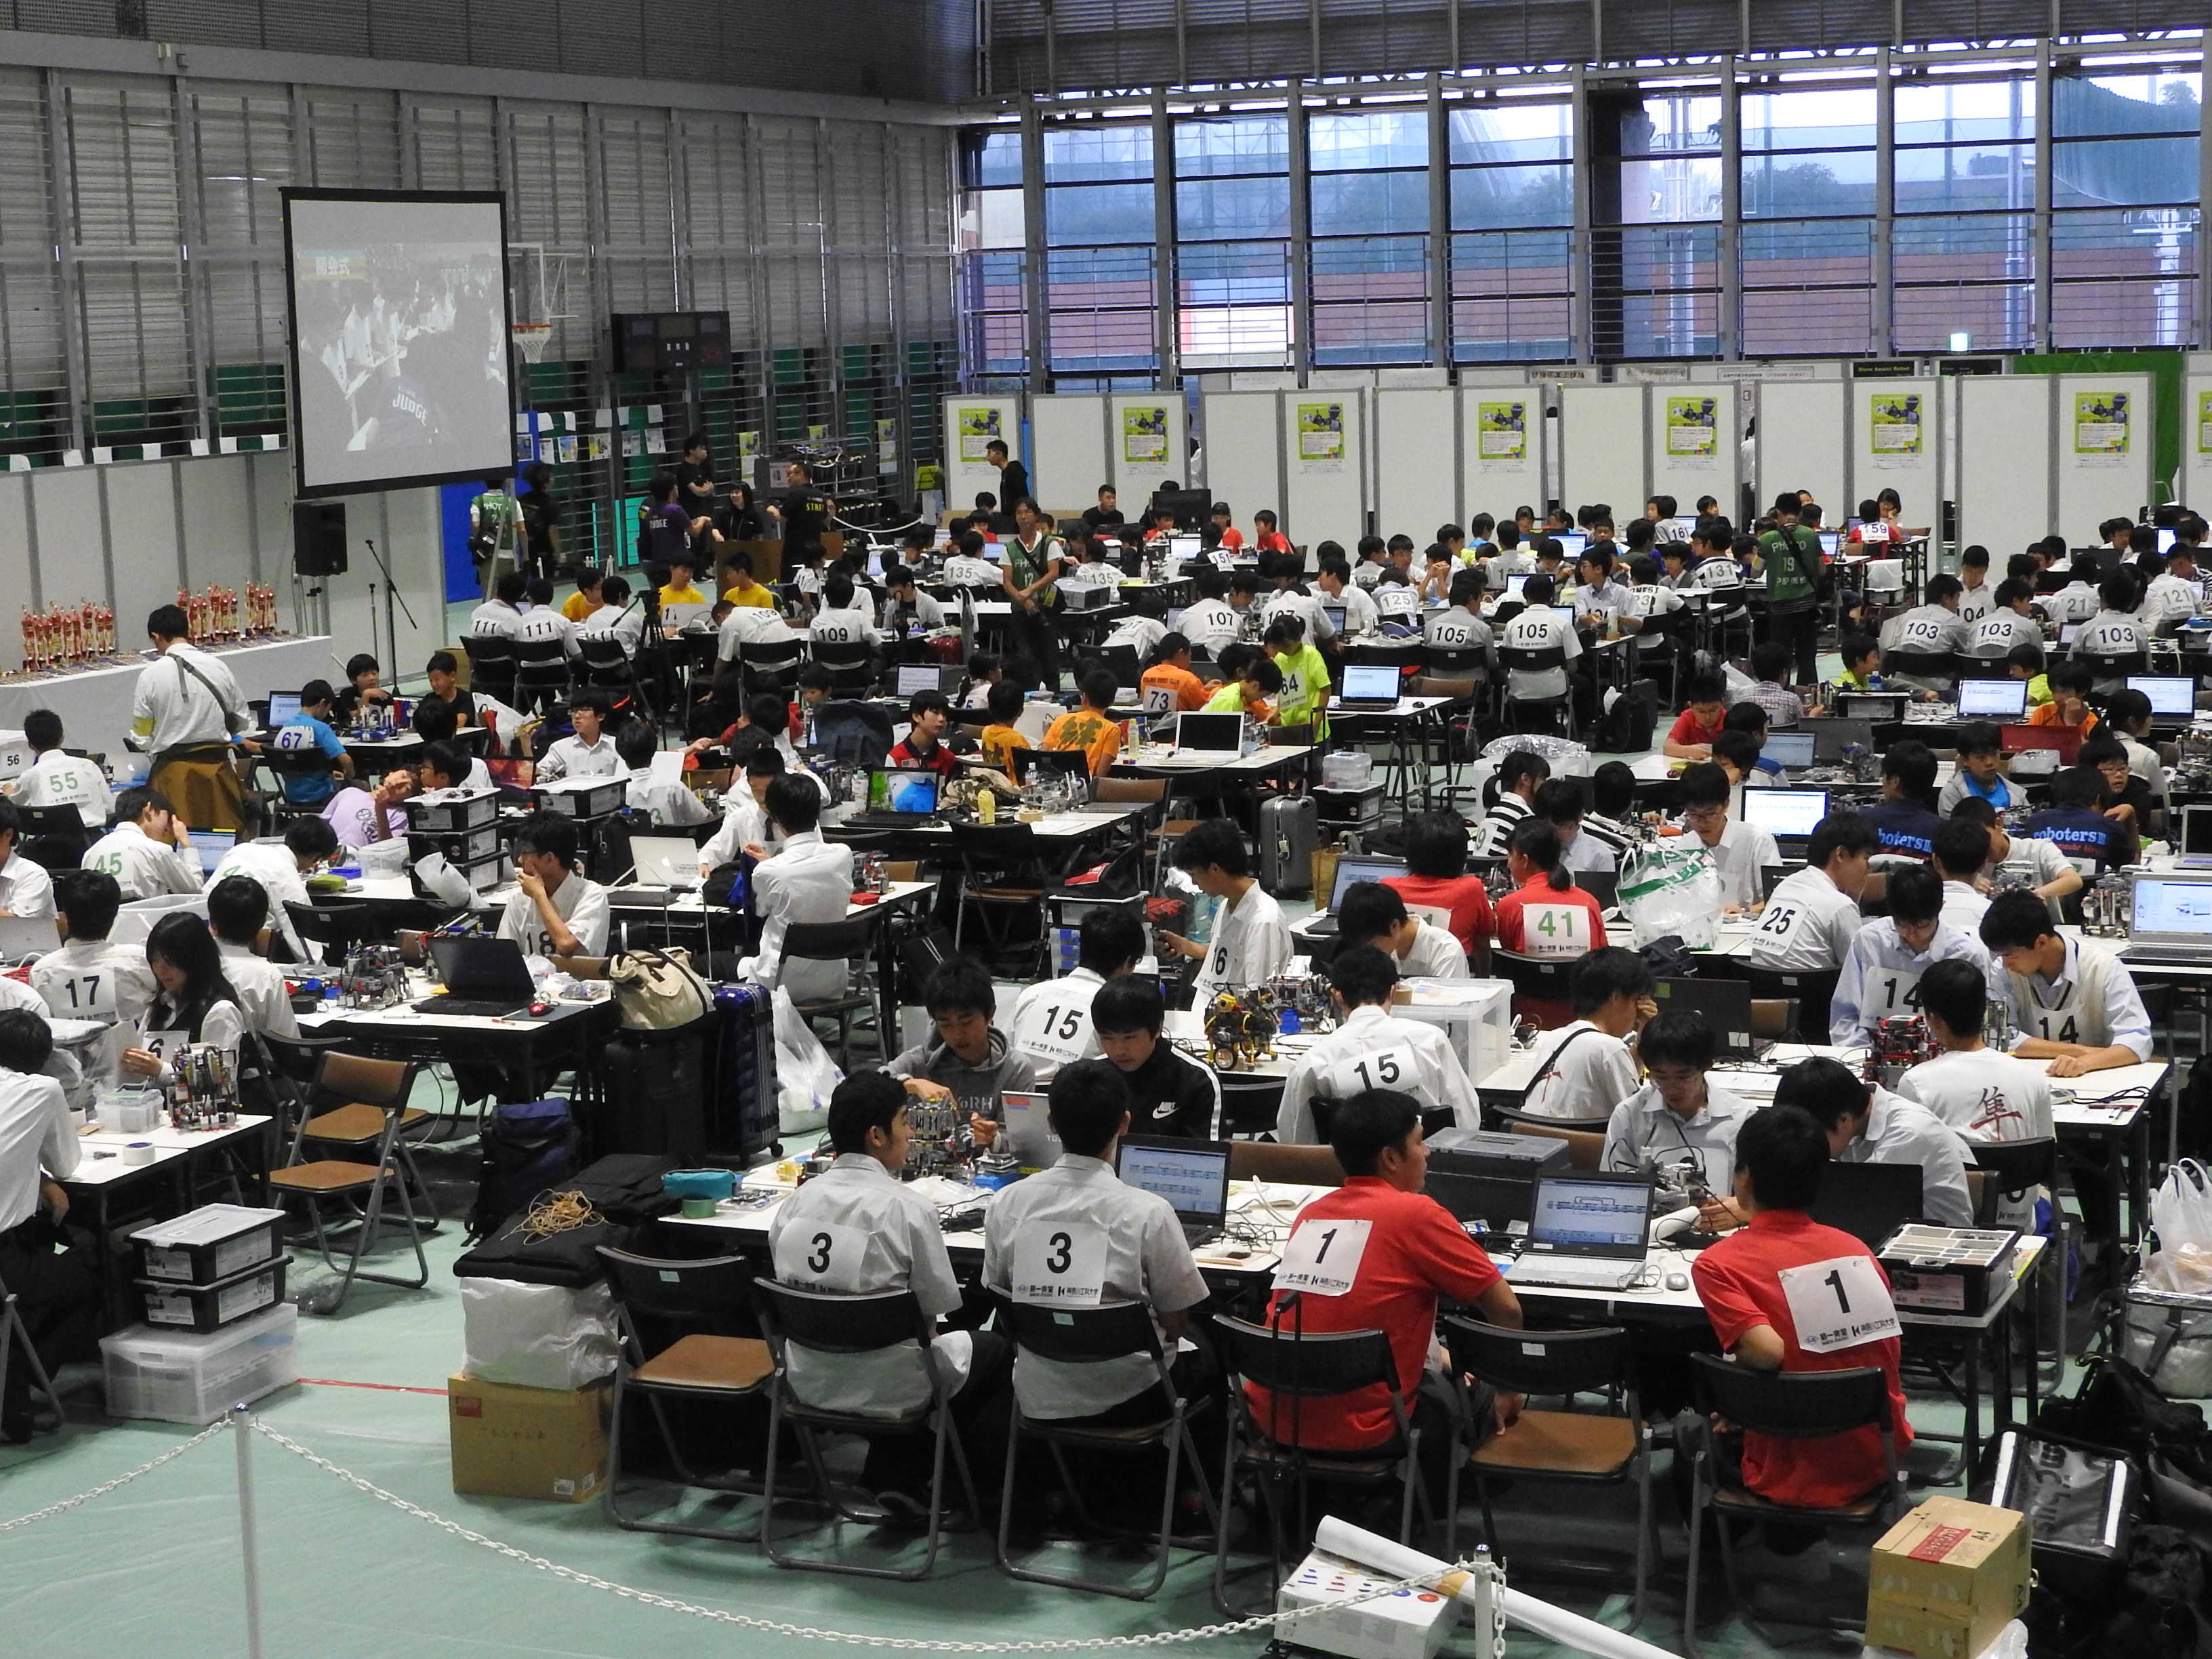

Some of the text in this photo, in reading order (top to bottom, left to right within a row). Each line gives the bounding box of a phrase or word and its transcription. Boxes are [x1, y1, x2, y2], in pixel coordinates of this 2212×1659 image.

[392, 392, 428, 426] JUDGE
[1864, 523, 1887, 534] 159
[949, 567, 973, 579] 135
[1706, 564, 1734, 579] 131
[1782, 557, 1795, 572] 19
[1090, 573, 1114, 585] 135
[1382, 594, 1412, 608] 125
[2162, 588, 2190, 605] 121
[752, 609, 778, 620] 109
[1206, 611, 1233, 626] 107
[474, 619, 497, 635] 111
[525, 621, 552, 638] 111
[819, 628, 848, 642] 109
[1436, 626, 1466, 644] 105
[1517, 623, 1548, 639] 105
[1906, 622, 1939, 640] 103
[1980, 623, 2012, 637] 103
[2099, 628, 2134, 644] 103
[1280, 674, 1300, 696] 64
[1149, 691, 1169, 711] 73
[281, 731, 303, 750] 67
[7, 754, 20, 766] 56
[49, 771, 79, 794] 55
[94, 852, 123, 876] 45
[1538, 910, 1573, 937] 41
[1761, 906, 1796, 935] 25
[1211, 945, 1228, 976] 16
[65, 975, 100, 1008] 17
[1884, 977, 1924, 1013] 14
[1043, 1005, 1084, 1040] 15
[2039, 1015, 2079, 1044] 14
[1353, 1053, 1399, 1090] 15
[1158, 1101, 1176, 1111] NIKE
[1969, 1086, 2024, 1141] 隼
[807, 1231, 832, 1273] 3
[1046, 1231, 1071, 1274] 3
[1315, 1228, 1337, 1264] 1
[1824, 1269, 1850, 1314] 1
[1971, 1530, 1992, 1542] A4
